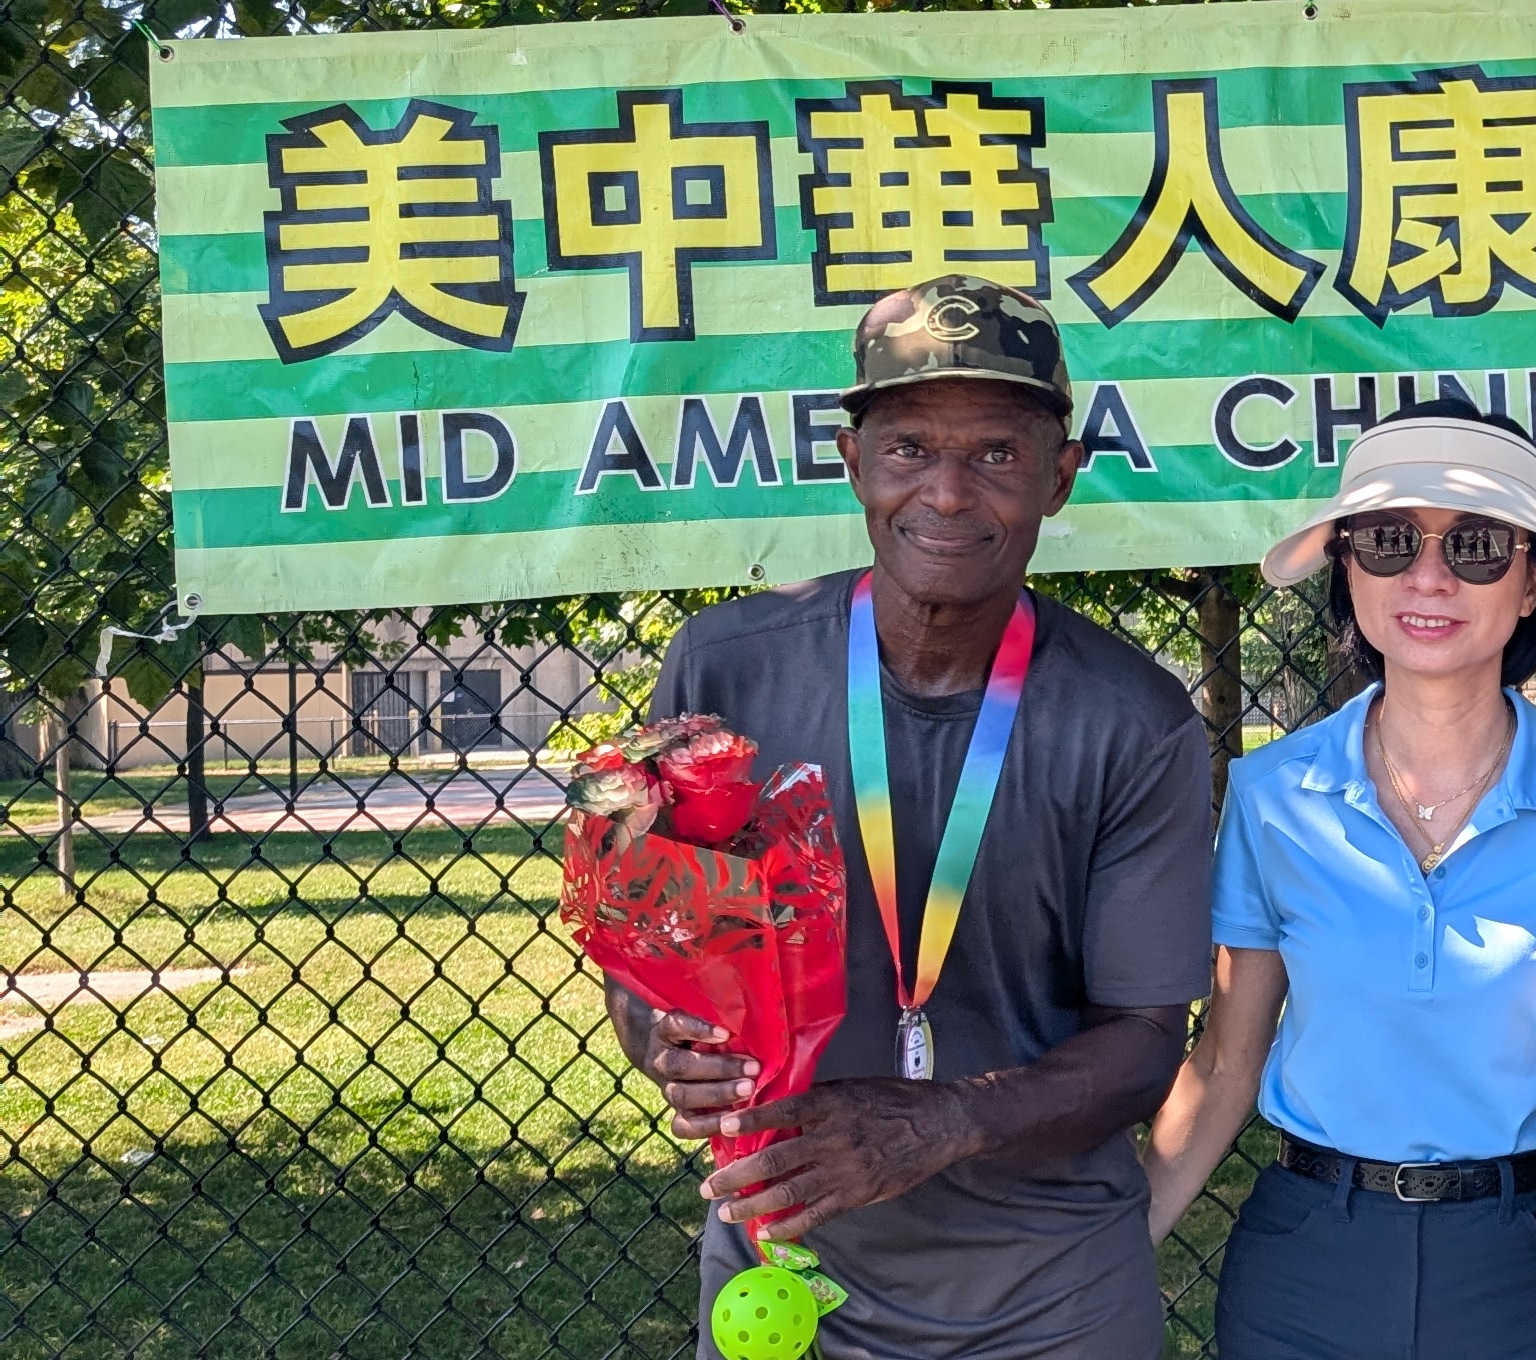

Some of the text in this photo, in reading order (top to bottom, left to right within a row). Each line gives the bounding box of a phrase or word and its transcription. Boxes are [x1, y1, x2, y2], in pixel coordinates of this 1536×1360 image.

[926, 295, 980, 341] C
[280, 409, 518, 513] MID
[574, 381, 1157, 496] AMEA
